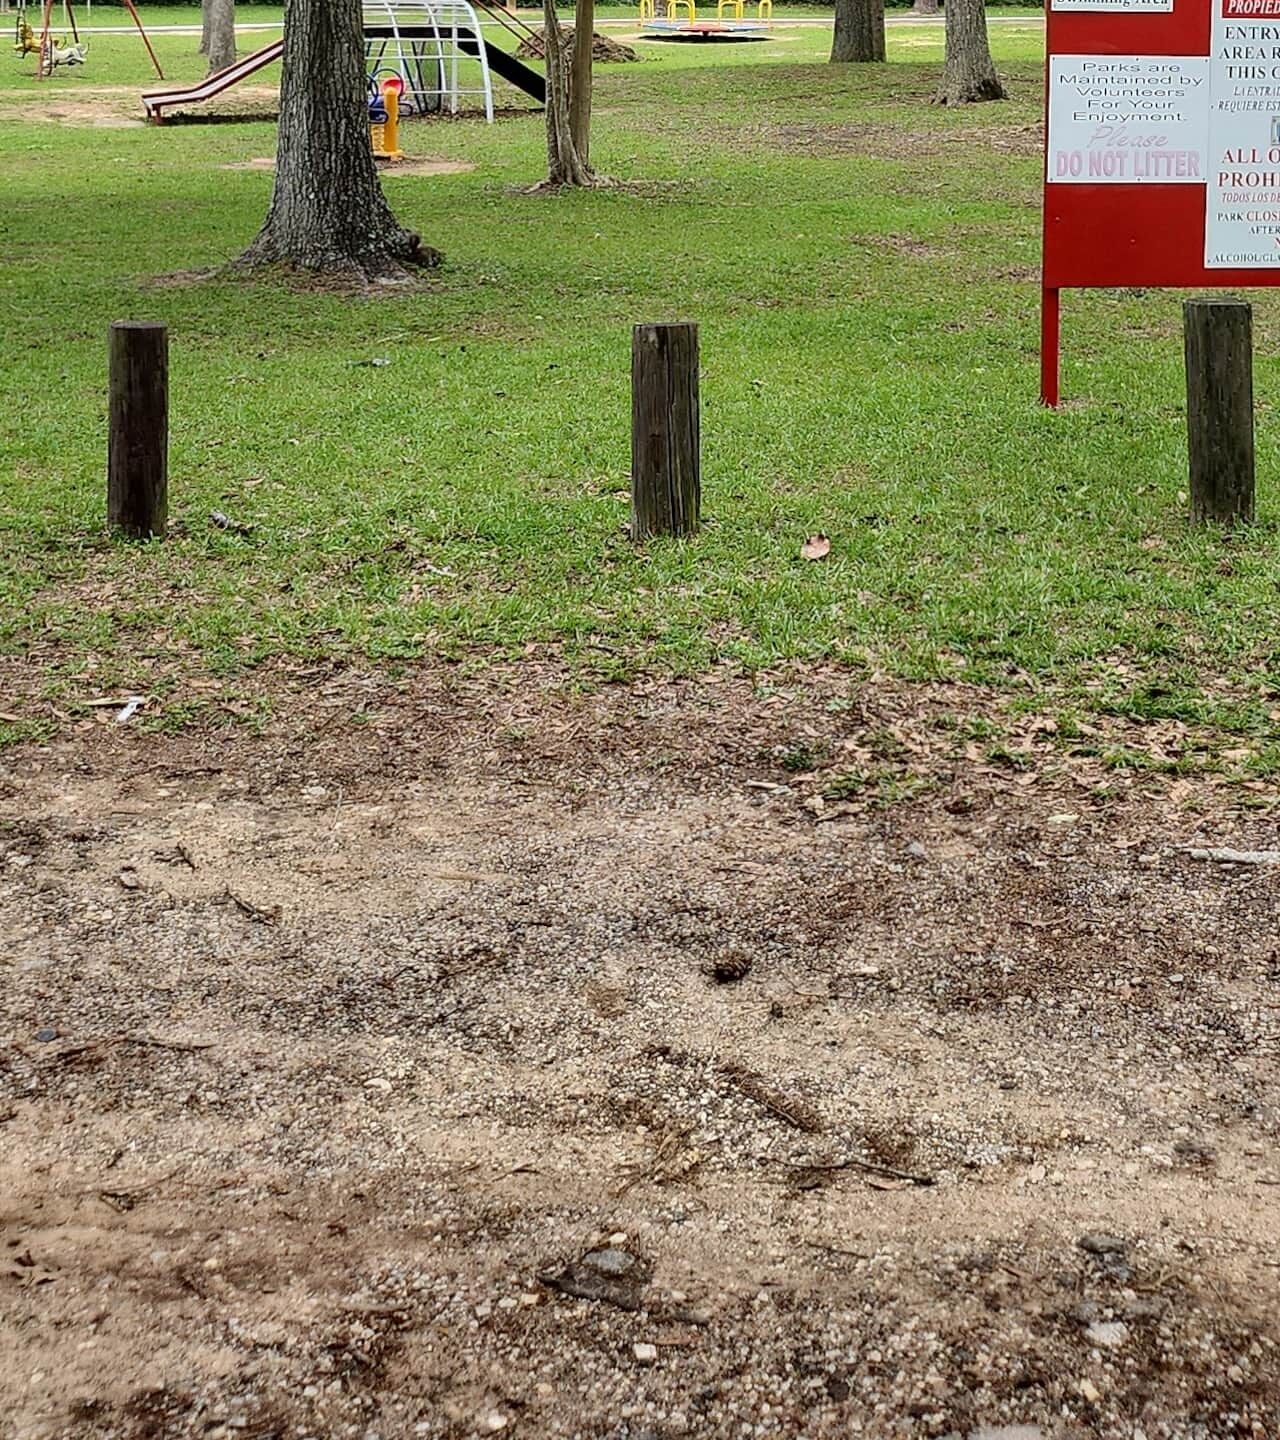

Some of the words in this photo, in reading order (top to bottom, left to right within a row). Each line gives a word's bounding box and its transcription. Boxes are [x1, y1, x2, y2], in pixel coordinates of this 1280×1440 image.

[1220, 47, 1266, 59] AREA
[1083, 63, 1141, 72] Parks
[1226, 66, 1266, 79] THIS
[1060, 75, 1171, 84] Maintained
[1180, 76, 1203, 86] by
[1077, 87, 1185, 96] Volunteers
[1088, 100, 1121, 108] For
[1128, 100, 1175, 109] Your
[1219, 101, 1264, 112] REQUIERE
[1086, 125, 1169, 148] Please
[1222, 149, 1263, 163] ALL
[1056, 151, 1082, 176] DO
[1089, 151, 1128, 176] NOT
[1134, 151, 1200, 176] LITTER
[1222, 192, 1250, 202] TODOS
[1252, 192, 1268, 202] LOS
[1217, 212, 1243, 221] PARK
[1249, 226, 1280, 234] AFTER
